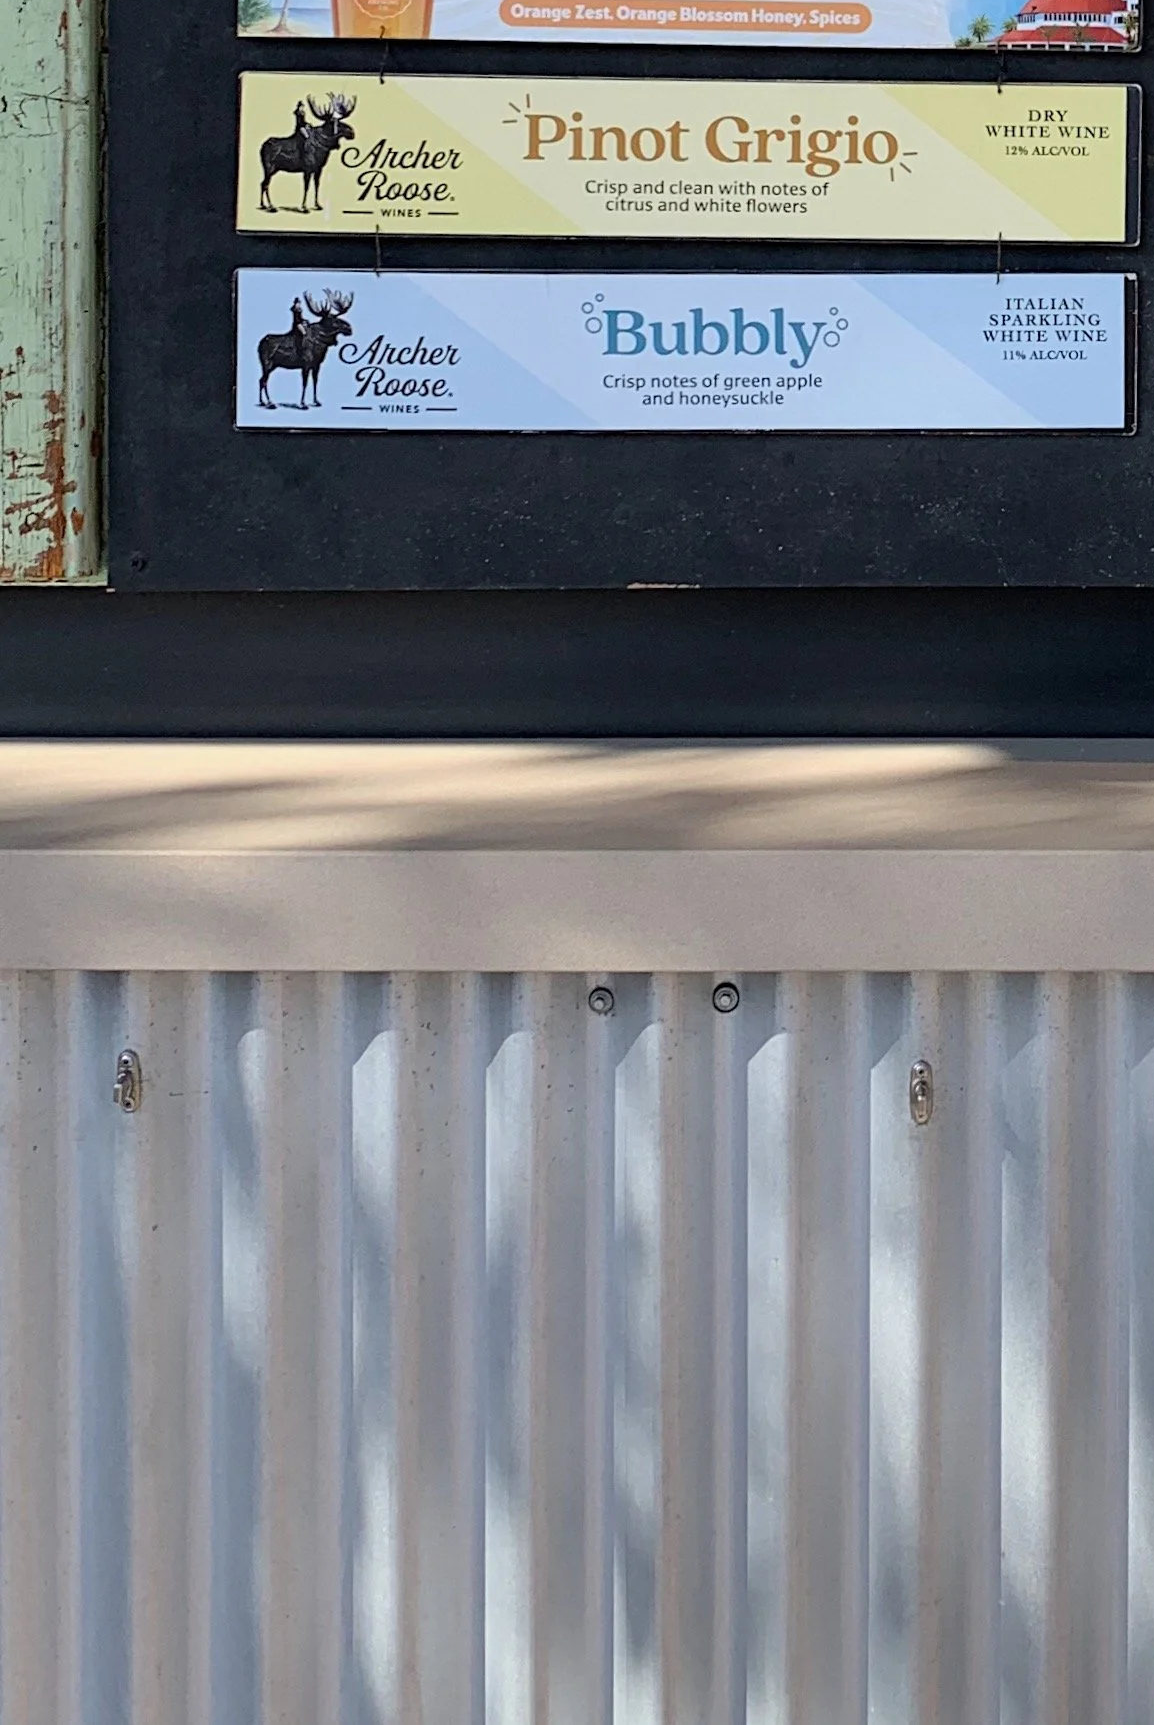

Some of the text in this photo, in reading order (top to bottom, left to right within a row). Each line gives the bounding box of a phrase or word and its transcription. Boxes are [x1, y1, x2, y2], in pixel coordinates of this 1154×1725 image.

[511, 2, 860, 27] Orange Orange Blossom Spices
[1028, 109, 1068, 122] DRY
[986, 125, 1110, 138] WHITE WINE
[523, 112, 899, 178] Pinot Grigio
[1005, 146, 1090, 156] 12% ALC/VOL
[341, 138, 464, 169] Archer
[585, 180, 829, 197] Crisp and clean with notes of
[606, 198, 808, 213] citrus and white flowers
[380, 208, 422, 218] WINES
[1005, 298, 1085, 310] ITALIAN
[989, 314, 1101, 326] SPARKLING
[602, 307, 828, 369] Bubbly
[983, 330, 1108, 342] WHITE WINE
[338, 335, 461, 365] Archer
[1003, 350, 1087, 360] 11% ALC/VOL
[603, 374, 823, 391] Crisp notes of green apple
[642, 391, 784, 408] and honeysuckle
[379, 404, 420, 414] WINES
